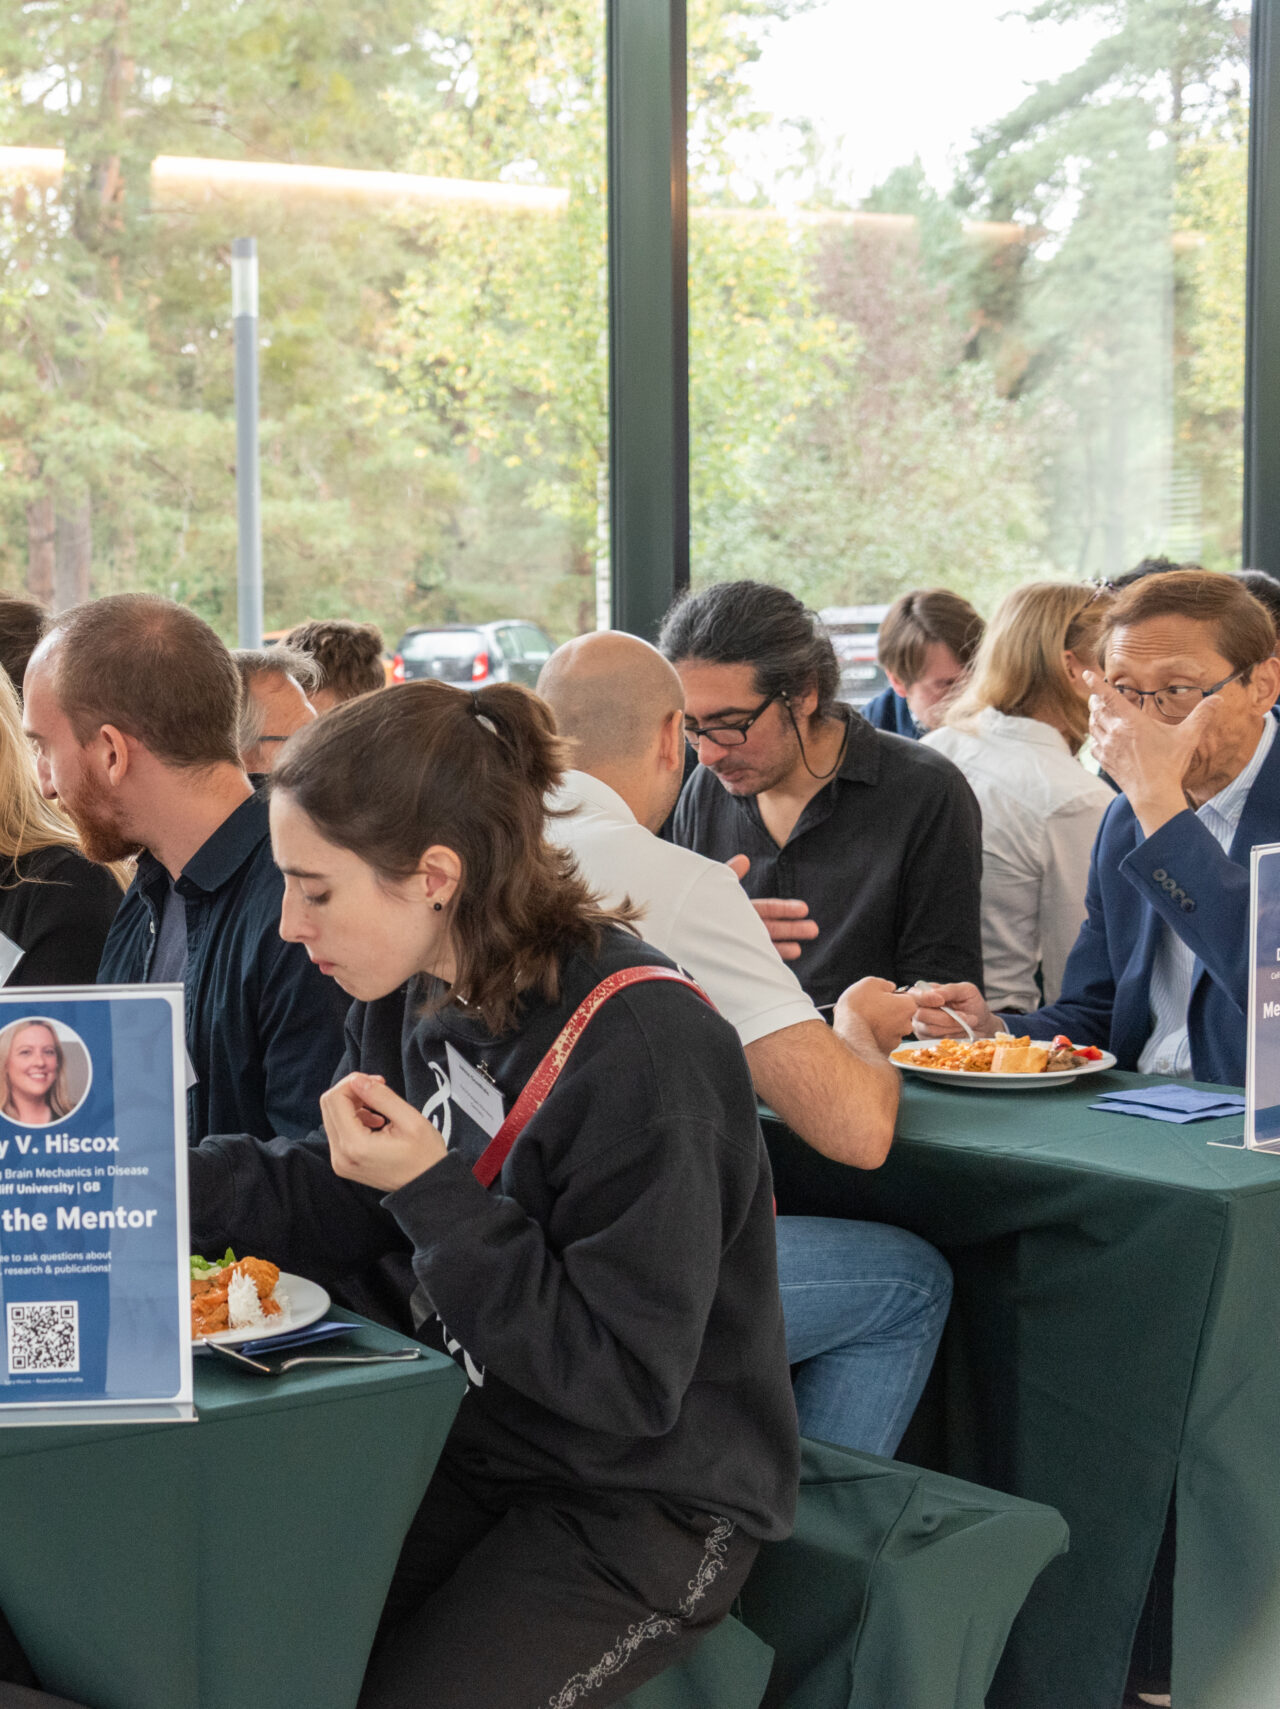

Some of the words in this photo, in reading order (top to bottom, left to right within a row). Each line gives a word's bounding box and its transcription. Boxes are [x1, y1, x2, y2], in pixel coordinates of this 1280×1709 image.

[15, 1135, 39, 1155] V.
[45, 1133, 120, 1154] Hiscox
[4, 1168, 33, 1179] Brain
[35, 1166, 93, 1179] Mechanics
[94, 1166, 105, 1176] in
[107, 1165, 149, 1177] Disease
[16, 1181, 75, 1195] University
[82, 1181, 101, 1193] GB
[2, 1207, 48, 1231] the
[56, 1206, 157, 1230] Mentor
[11, 1253, 21, 1262] to
[23, 1252, 39, 1262] ask
[40, 1251, 84, 1263] questions
[85, 1250, 112, 1260] about
[4, 1265, 43, 1275] research
[45, 1264, 52, 1274] &
[54, 1263, 112, 1276] publications!
